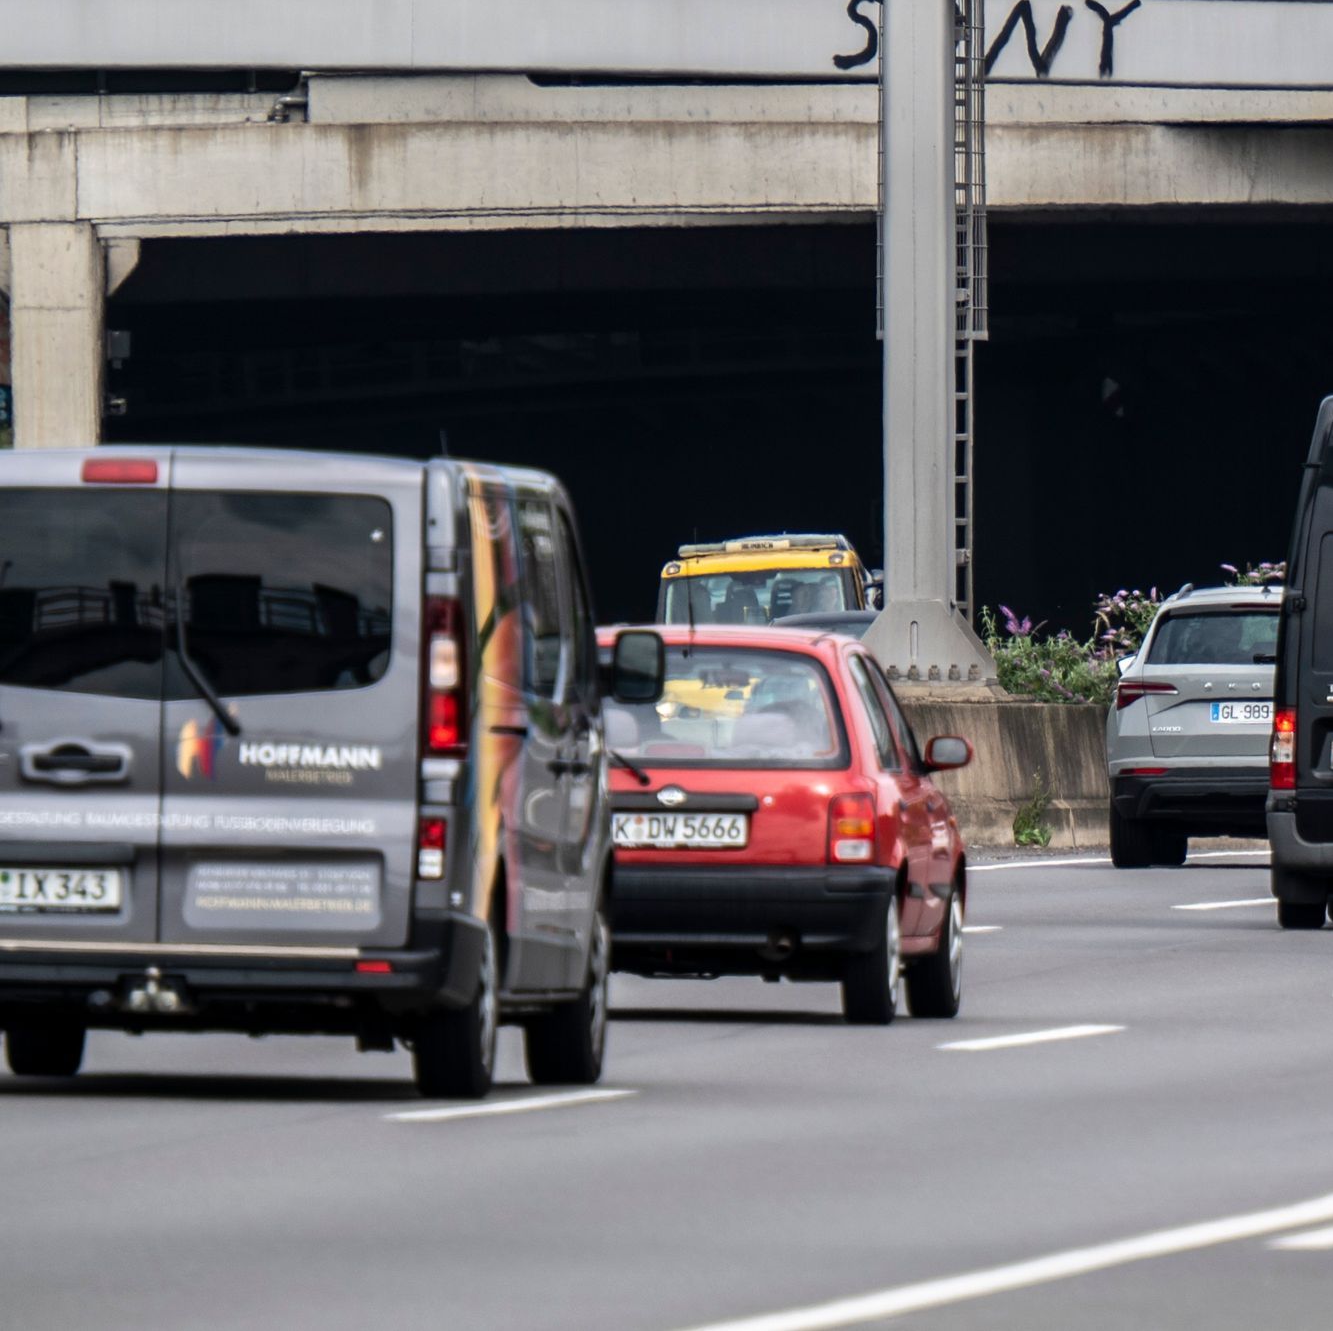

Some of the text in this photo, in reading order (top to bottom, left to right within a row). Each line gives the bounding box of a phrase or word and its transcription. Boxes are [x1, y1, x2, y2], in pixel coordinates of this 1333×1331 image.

[239, 743, 380, 769] HOFFMANN
[615, 817, 740, 839] K DW 5666
[56, 873, 106, 900] 343
